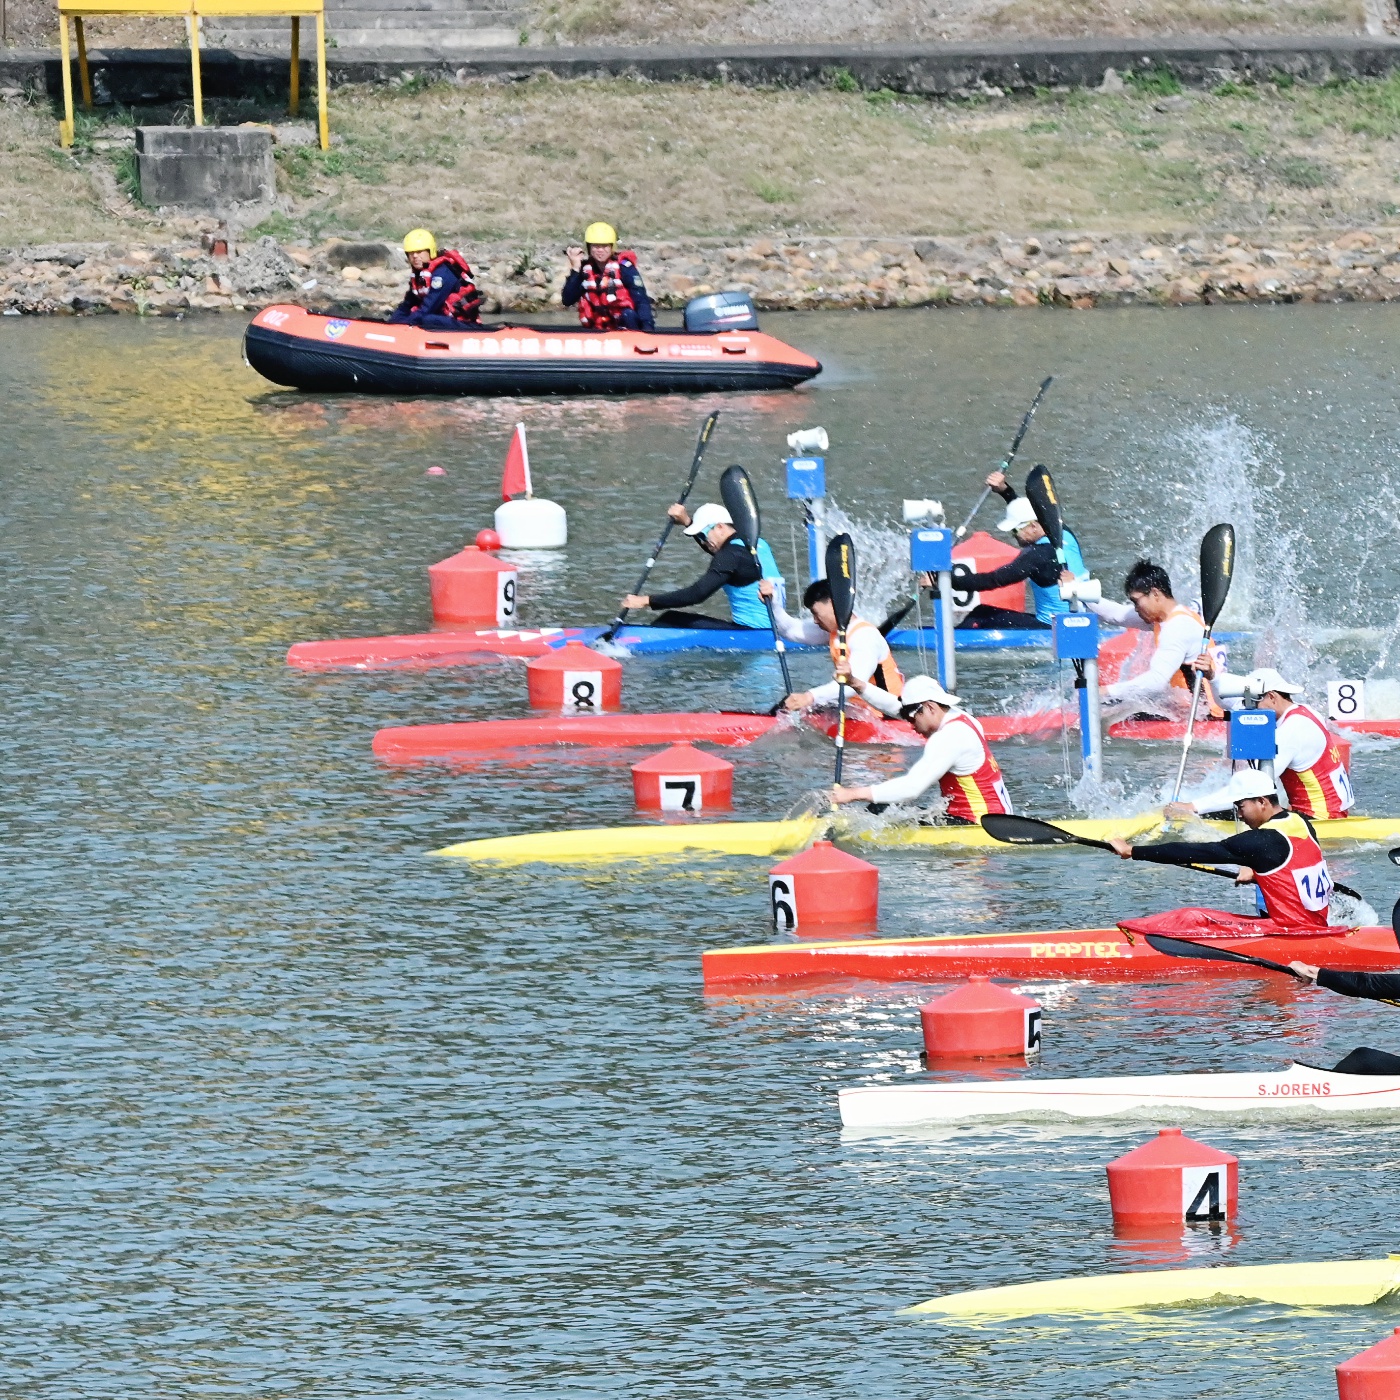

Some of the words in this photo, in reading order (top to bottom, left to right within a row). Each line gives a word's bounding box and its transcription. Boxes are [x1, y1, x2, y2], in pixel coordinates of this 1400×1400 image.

[503, 579, 516, 616] 9
[1337, 684, 1358, 714] 8
[665, 781, 696, 812] 7
[771, 880, 795, 931] 6
[1258, 1081, 1331, 1096] S.JORENS
[1186, 1172, 1226, 1222] 4
